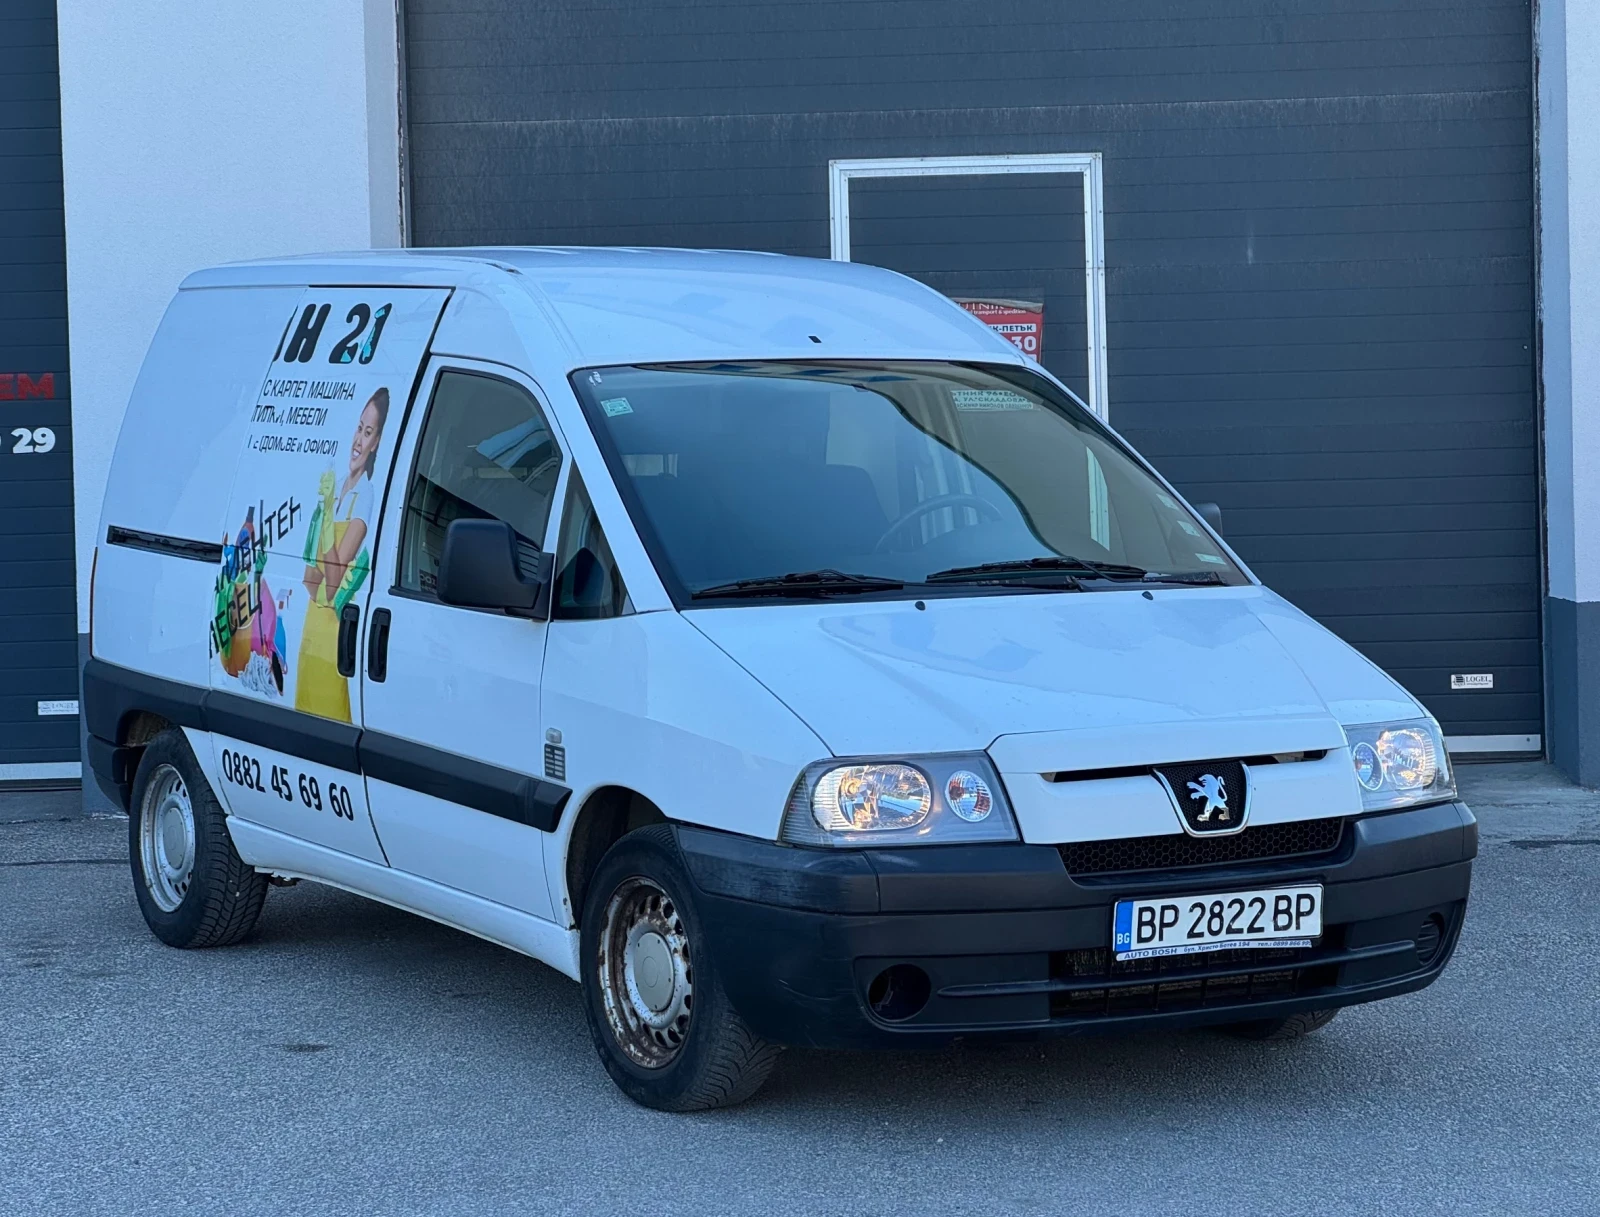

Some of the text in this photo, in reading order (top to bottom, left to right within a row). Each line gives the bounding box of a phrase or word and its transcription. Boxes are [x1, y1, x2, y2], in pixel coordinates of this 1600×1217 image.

[1002, 308, 1026, 316] spedition
[328, 302, 393, 365] 21
[308, 380, 357, 401] МАШИНА
[286, 406, 328, 426] МЕБЕЛИ
[10, 427, 56, 454] 29
[222, 748, 354, 821] 0882 45 69 60
[1136, 893, 1316, 944] BP 2822 BP
[1116, 932, 1130, 944] BG
[1123, 949, 1150, 960] AUTO
[1151, 947, 1178, 957] BOSH
